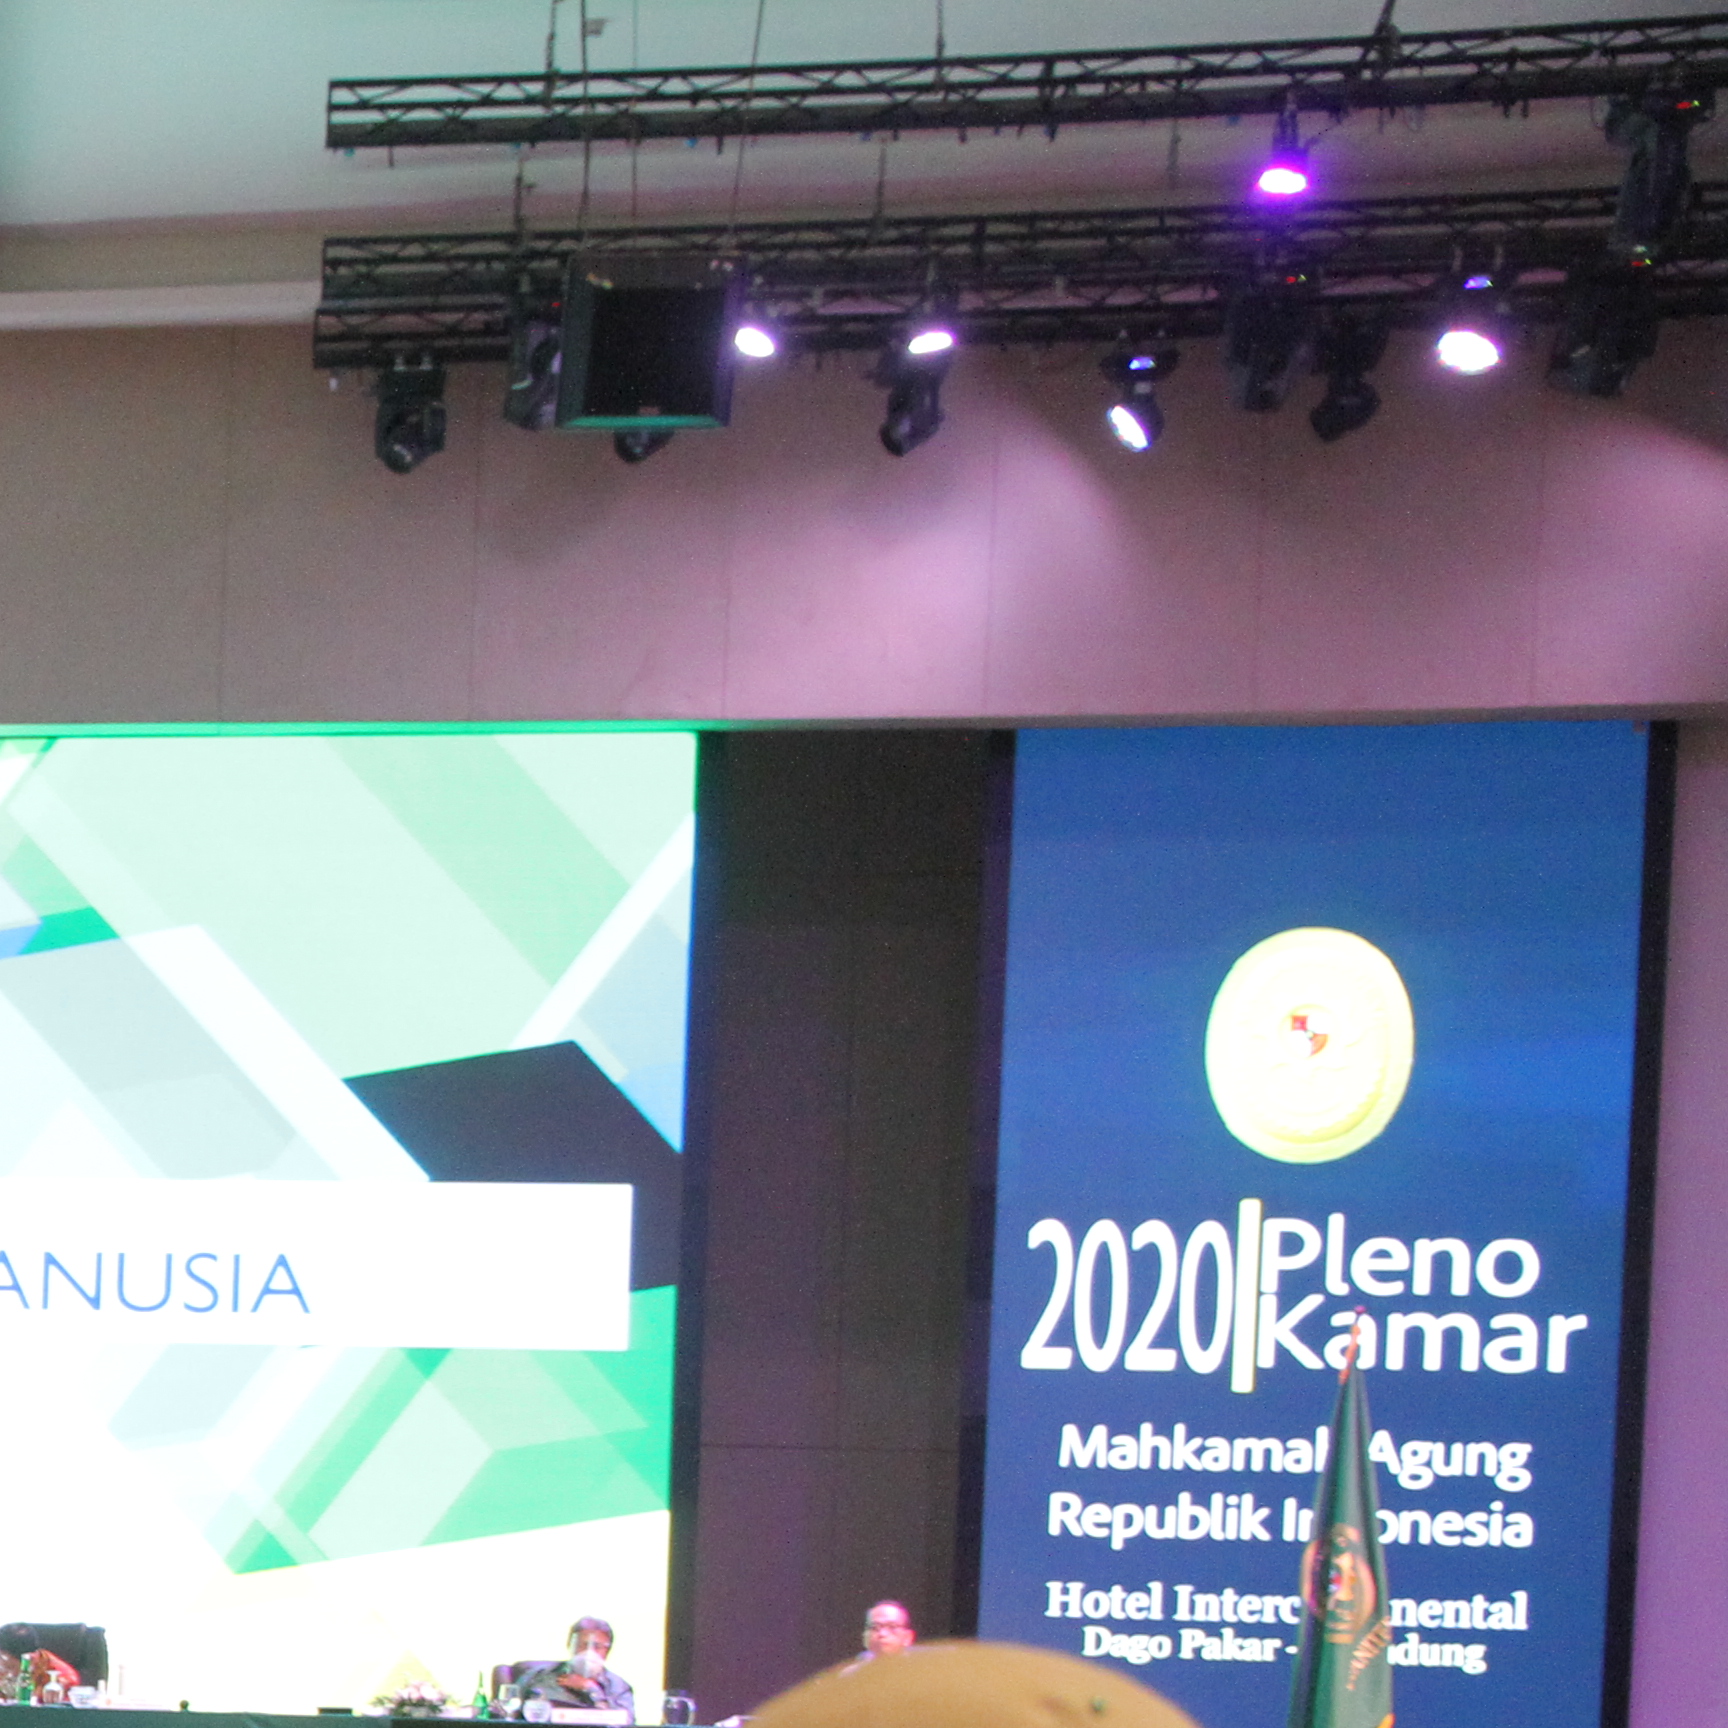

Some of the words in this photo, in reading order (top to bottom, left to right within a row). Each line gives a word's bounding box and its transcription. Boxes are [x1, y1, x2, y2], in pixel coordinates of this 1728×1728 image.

[1260, 1212, 1541, 1299] Pleno
[1020, 1218, 1234, 1374] 2020
[1256, 1294, 1589, 1375] Kamar
[1047, 1491, 1272, 1551] Republik
[1044, 1580, 1164, 1621] Hotel
[1173, 1583, 1529, 1632] Intercnental
[1081, 1625, 1173, 1666] Dago
